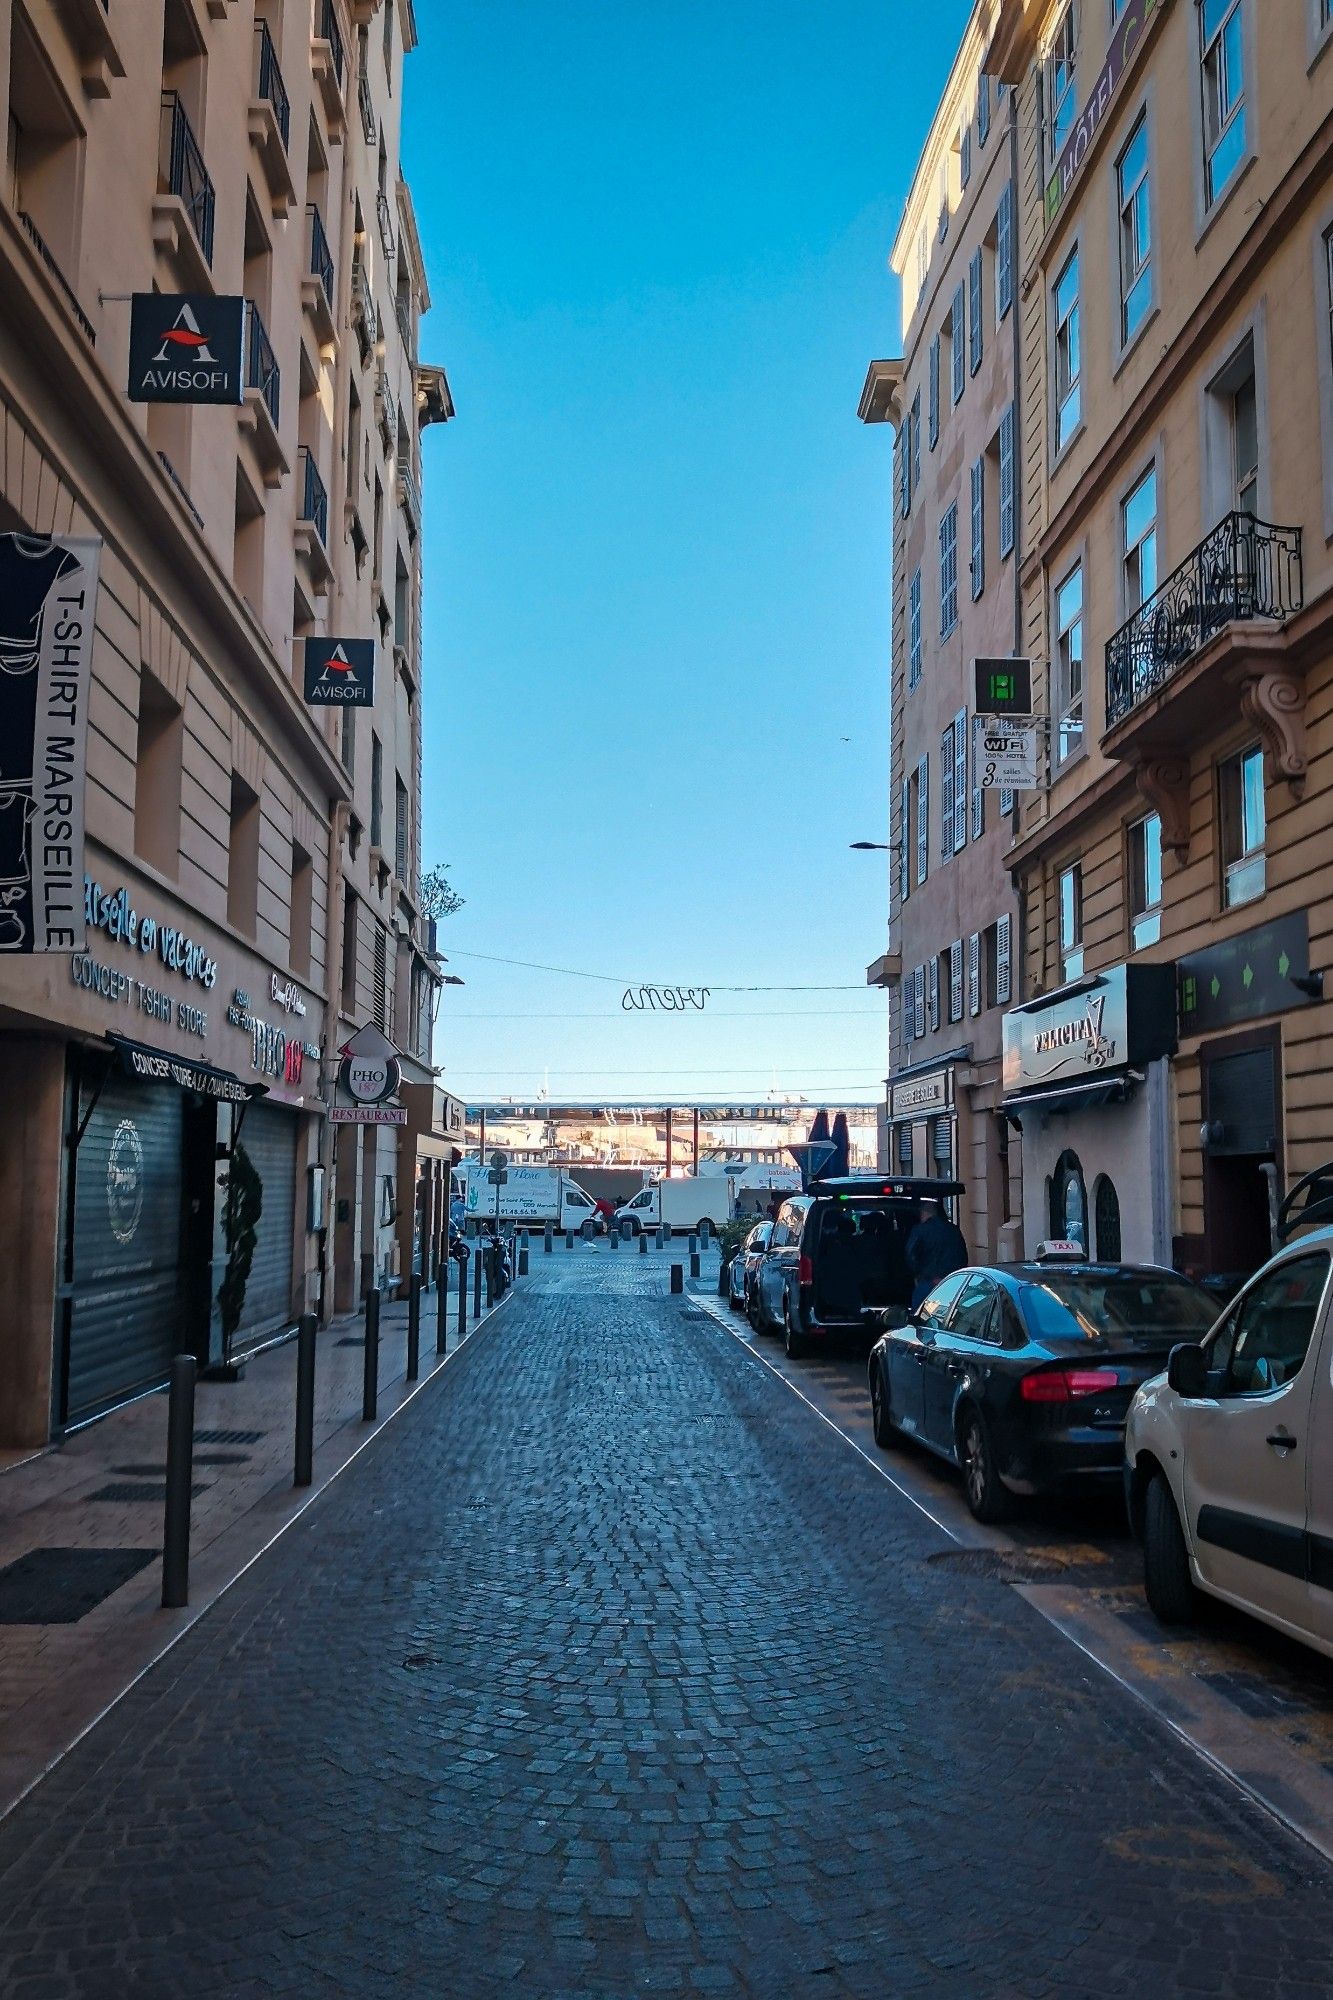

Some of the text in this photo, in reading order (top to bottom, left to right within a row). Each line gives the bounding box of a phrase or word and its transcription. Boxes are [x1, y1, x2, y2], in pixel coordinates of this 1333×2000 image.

[141, 370, 228, 390] AVISOFI
[311, 685, 366, 699] AVISOFI
[43, 589, 86, 948] T-SHIRT MARSEILLE
[982, 761, 996, 787] 3
[84, 875, 217, 989] arseille en vacances
[72, 954, 209, 1039] CONCEPT T-SHIRT STORE
[250, 1016, 286, 1077] PHO
[132, 1051, 172, 1077] CONCEP
[352, 1070, 384, 1082] PHO
[332, 1110, 405, 1121] RESTAURANT
[1051, 1242, 1075, 1250] TAXI
